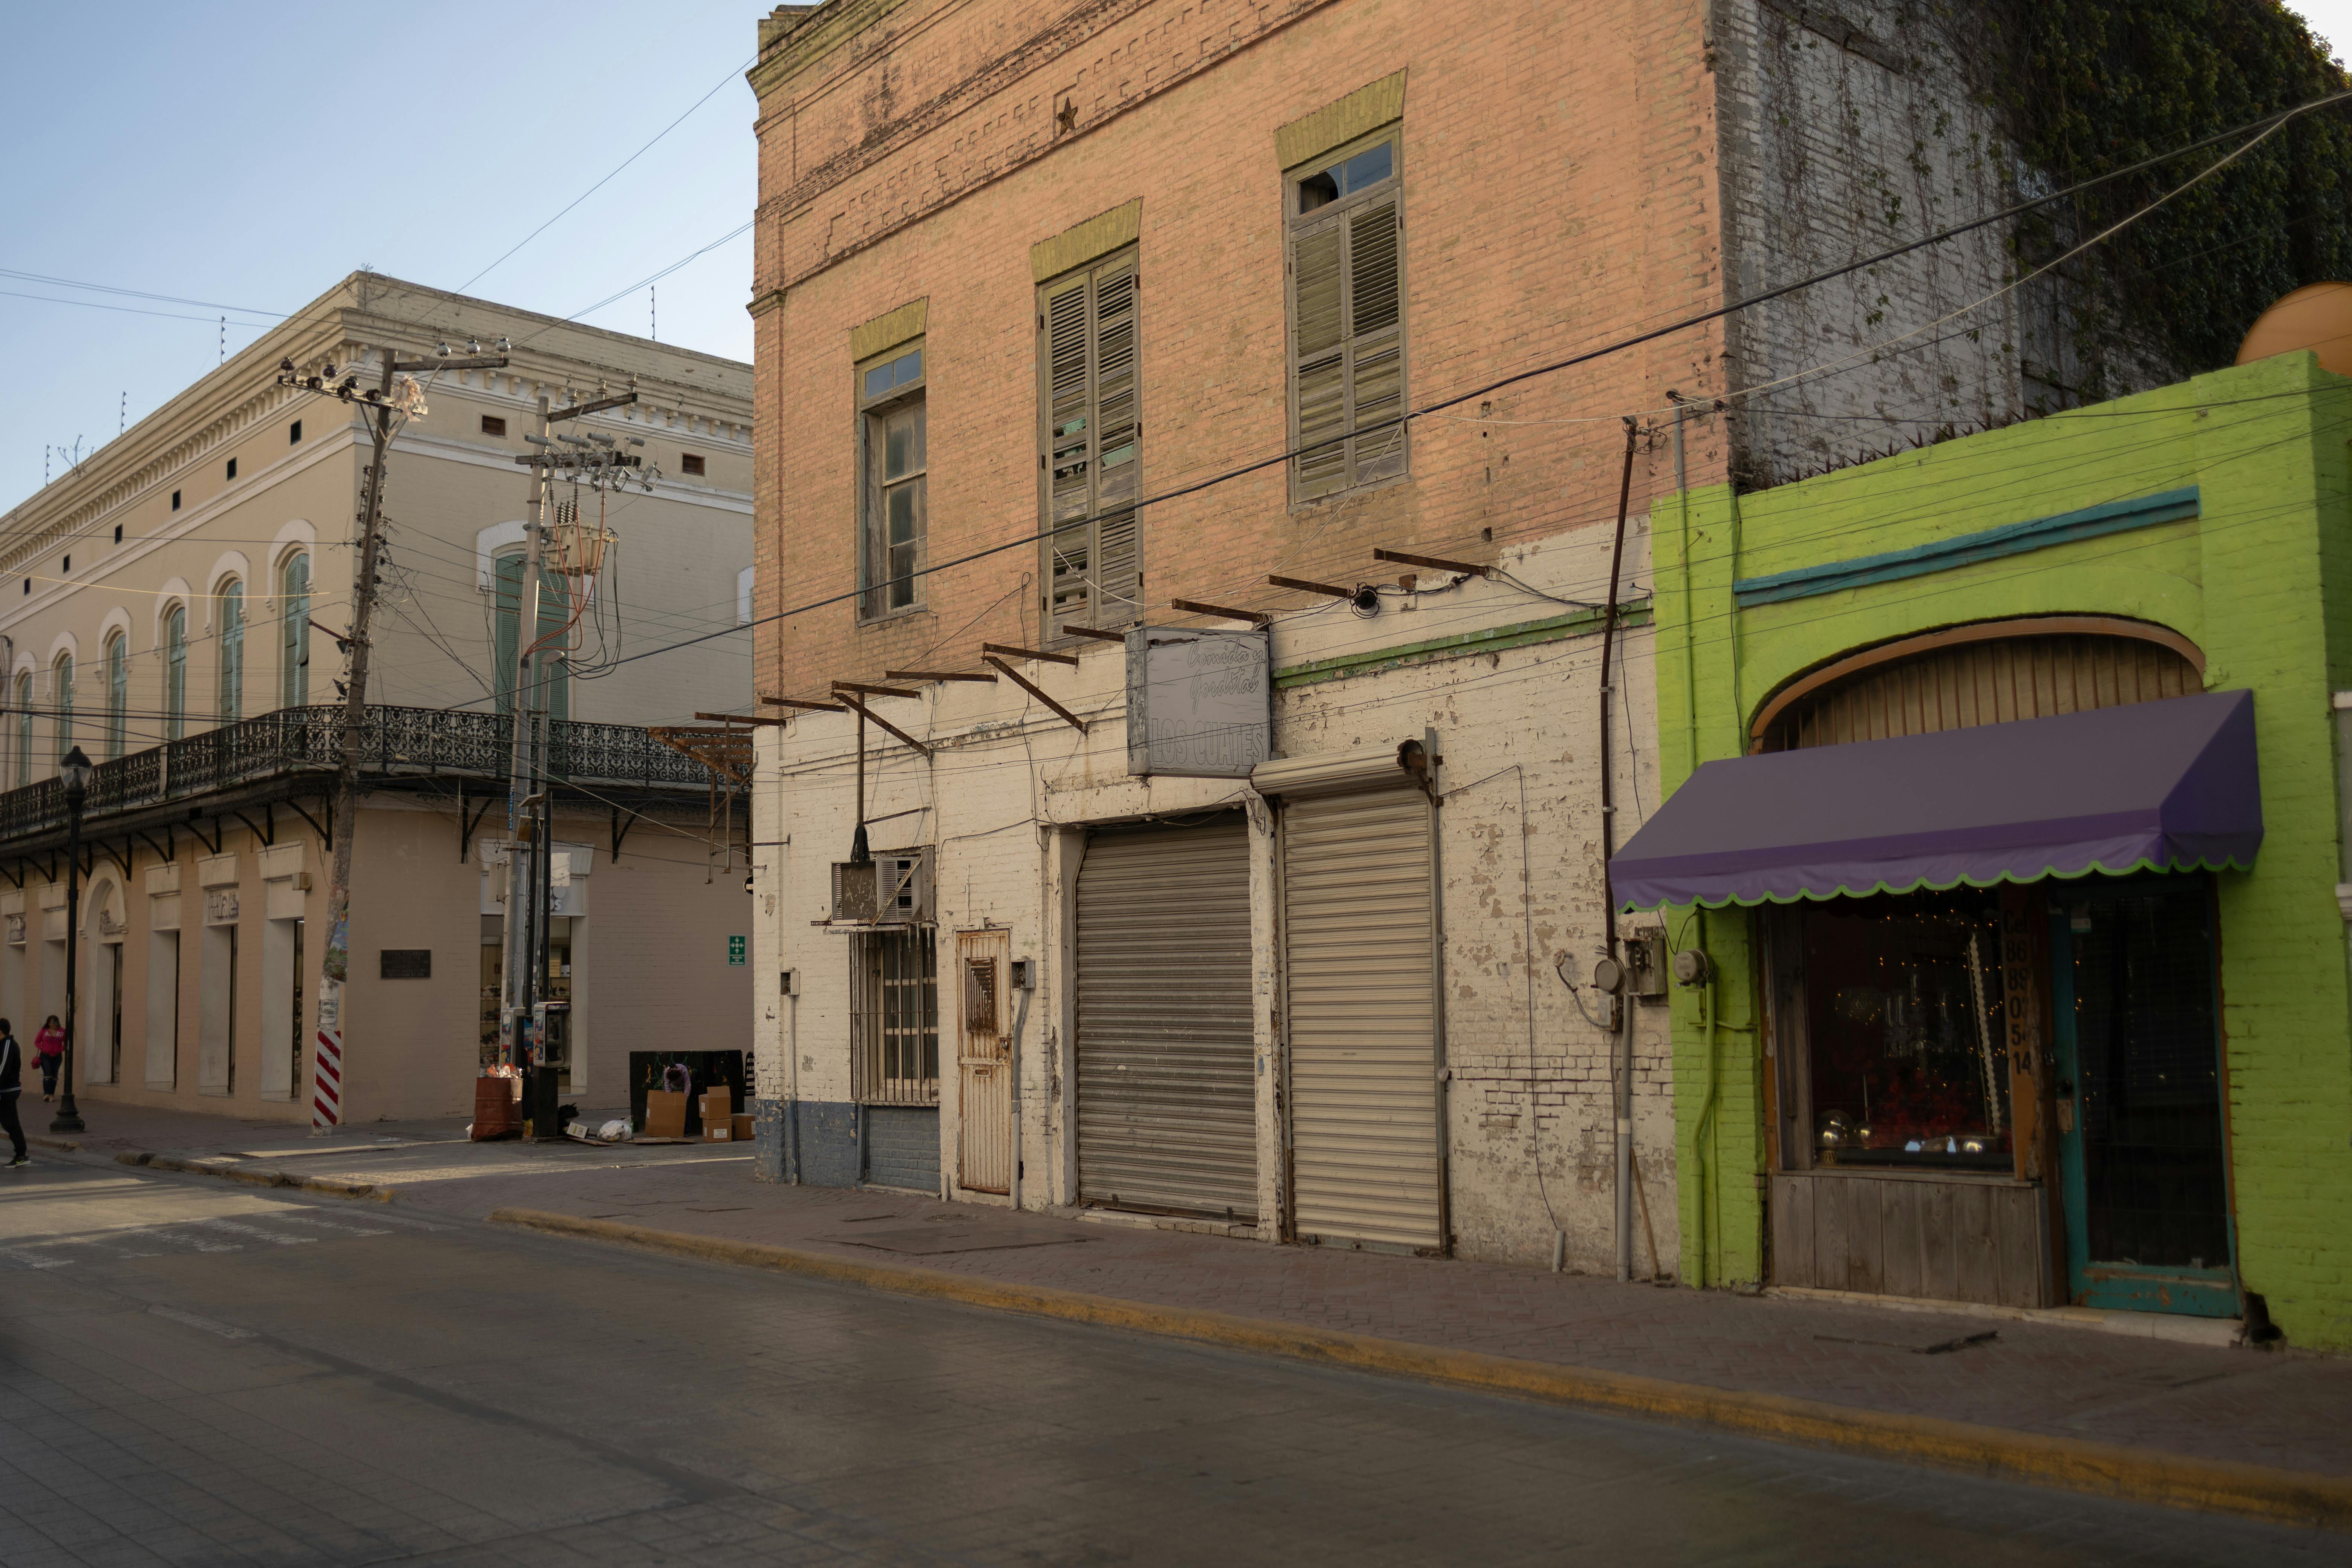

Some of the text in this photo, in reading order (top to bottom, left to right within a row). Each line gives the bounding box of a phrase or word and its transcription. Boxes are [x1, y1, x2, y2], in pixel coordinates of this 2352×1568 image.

[1187, 638, 1265, 677] Comida y
[1190, 666, 1259, 715] Gorditas
[1152, 718, 1264, 766] LOS CUATES
[2003, 909, 2029, 935] Cel
[2006, 940, 2027, 963] 86
[2013, 1051, 2031, 1075] 14
